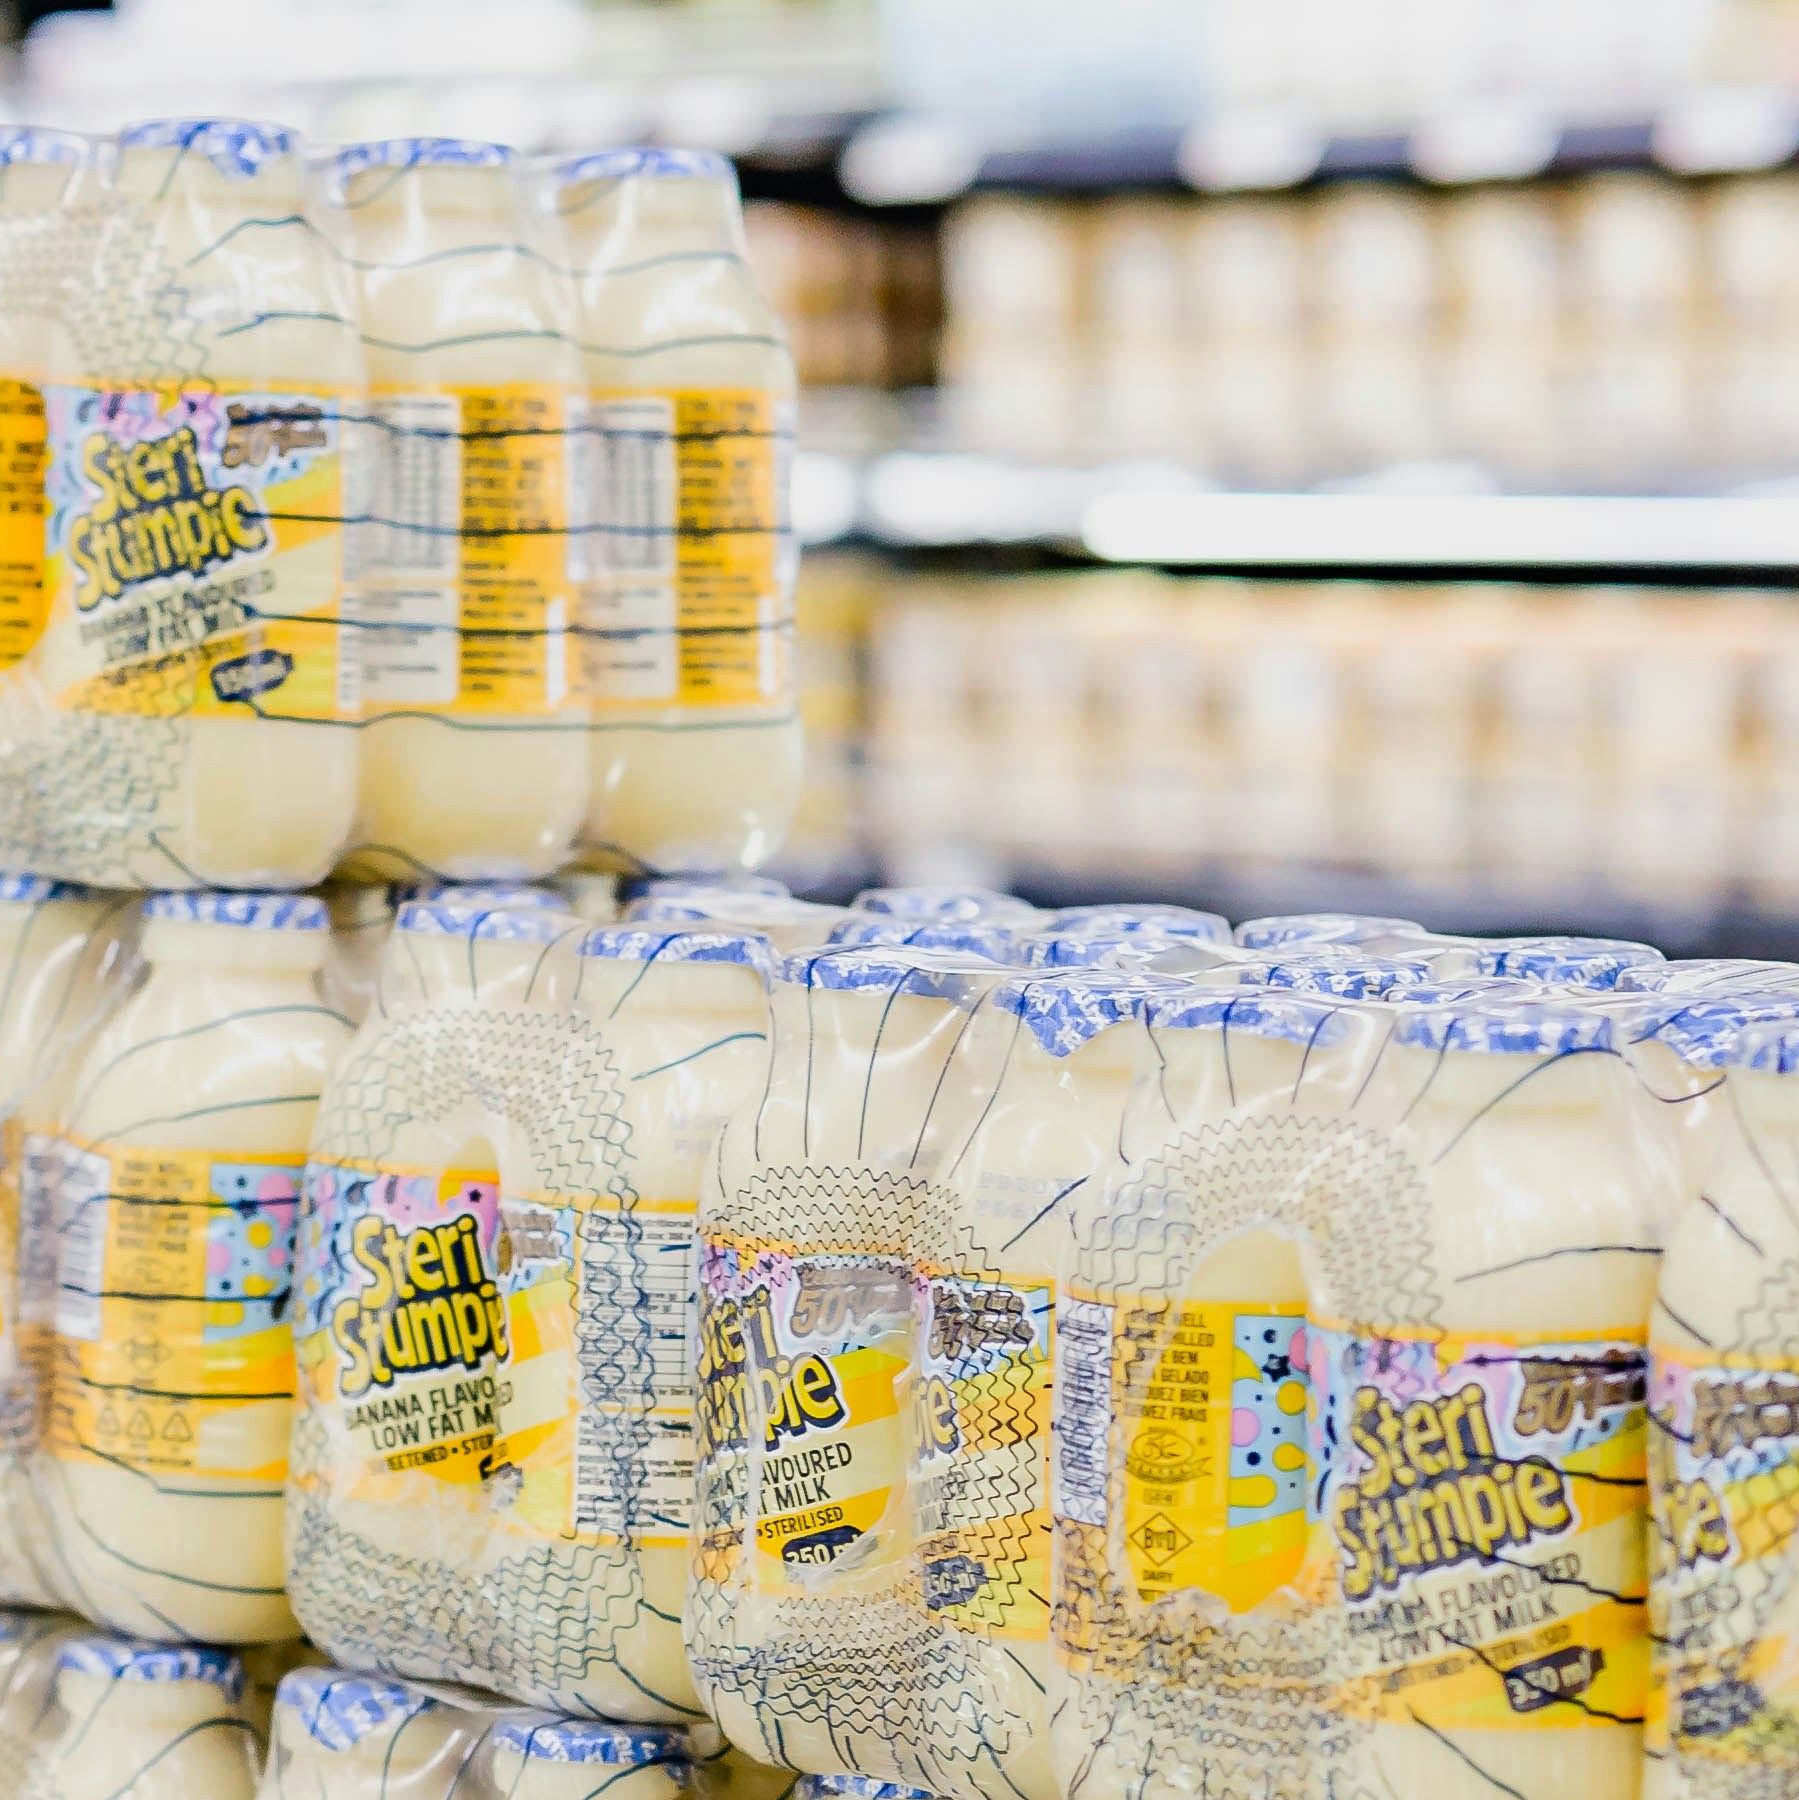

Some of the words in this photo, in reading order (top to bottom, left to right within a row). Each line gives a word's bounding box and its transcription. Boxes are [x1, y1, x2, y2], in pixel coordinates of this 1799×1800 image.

[351, 1213, 483, 1309] Steri
[347, 1394, 424, 1430] ANANA
[372, 1418, 420, 1451] LOW
[427, 1409, 465, 1440] FAT
[1351, 1383, 1495, 1498] Steri
[781, 1475, 832, 1511] MILK
[763, 1505, 845, 1540] STERILISED
[1333, 1455, 1574, 1602] Stumpie
[1494, 1590, 1560, 1632] MILK
